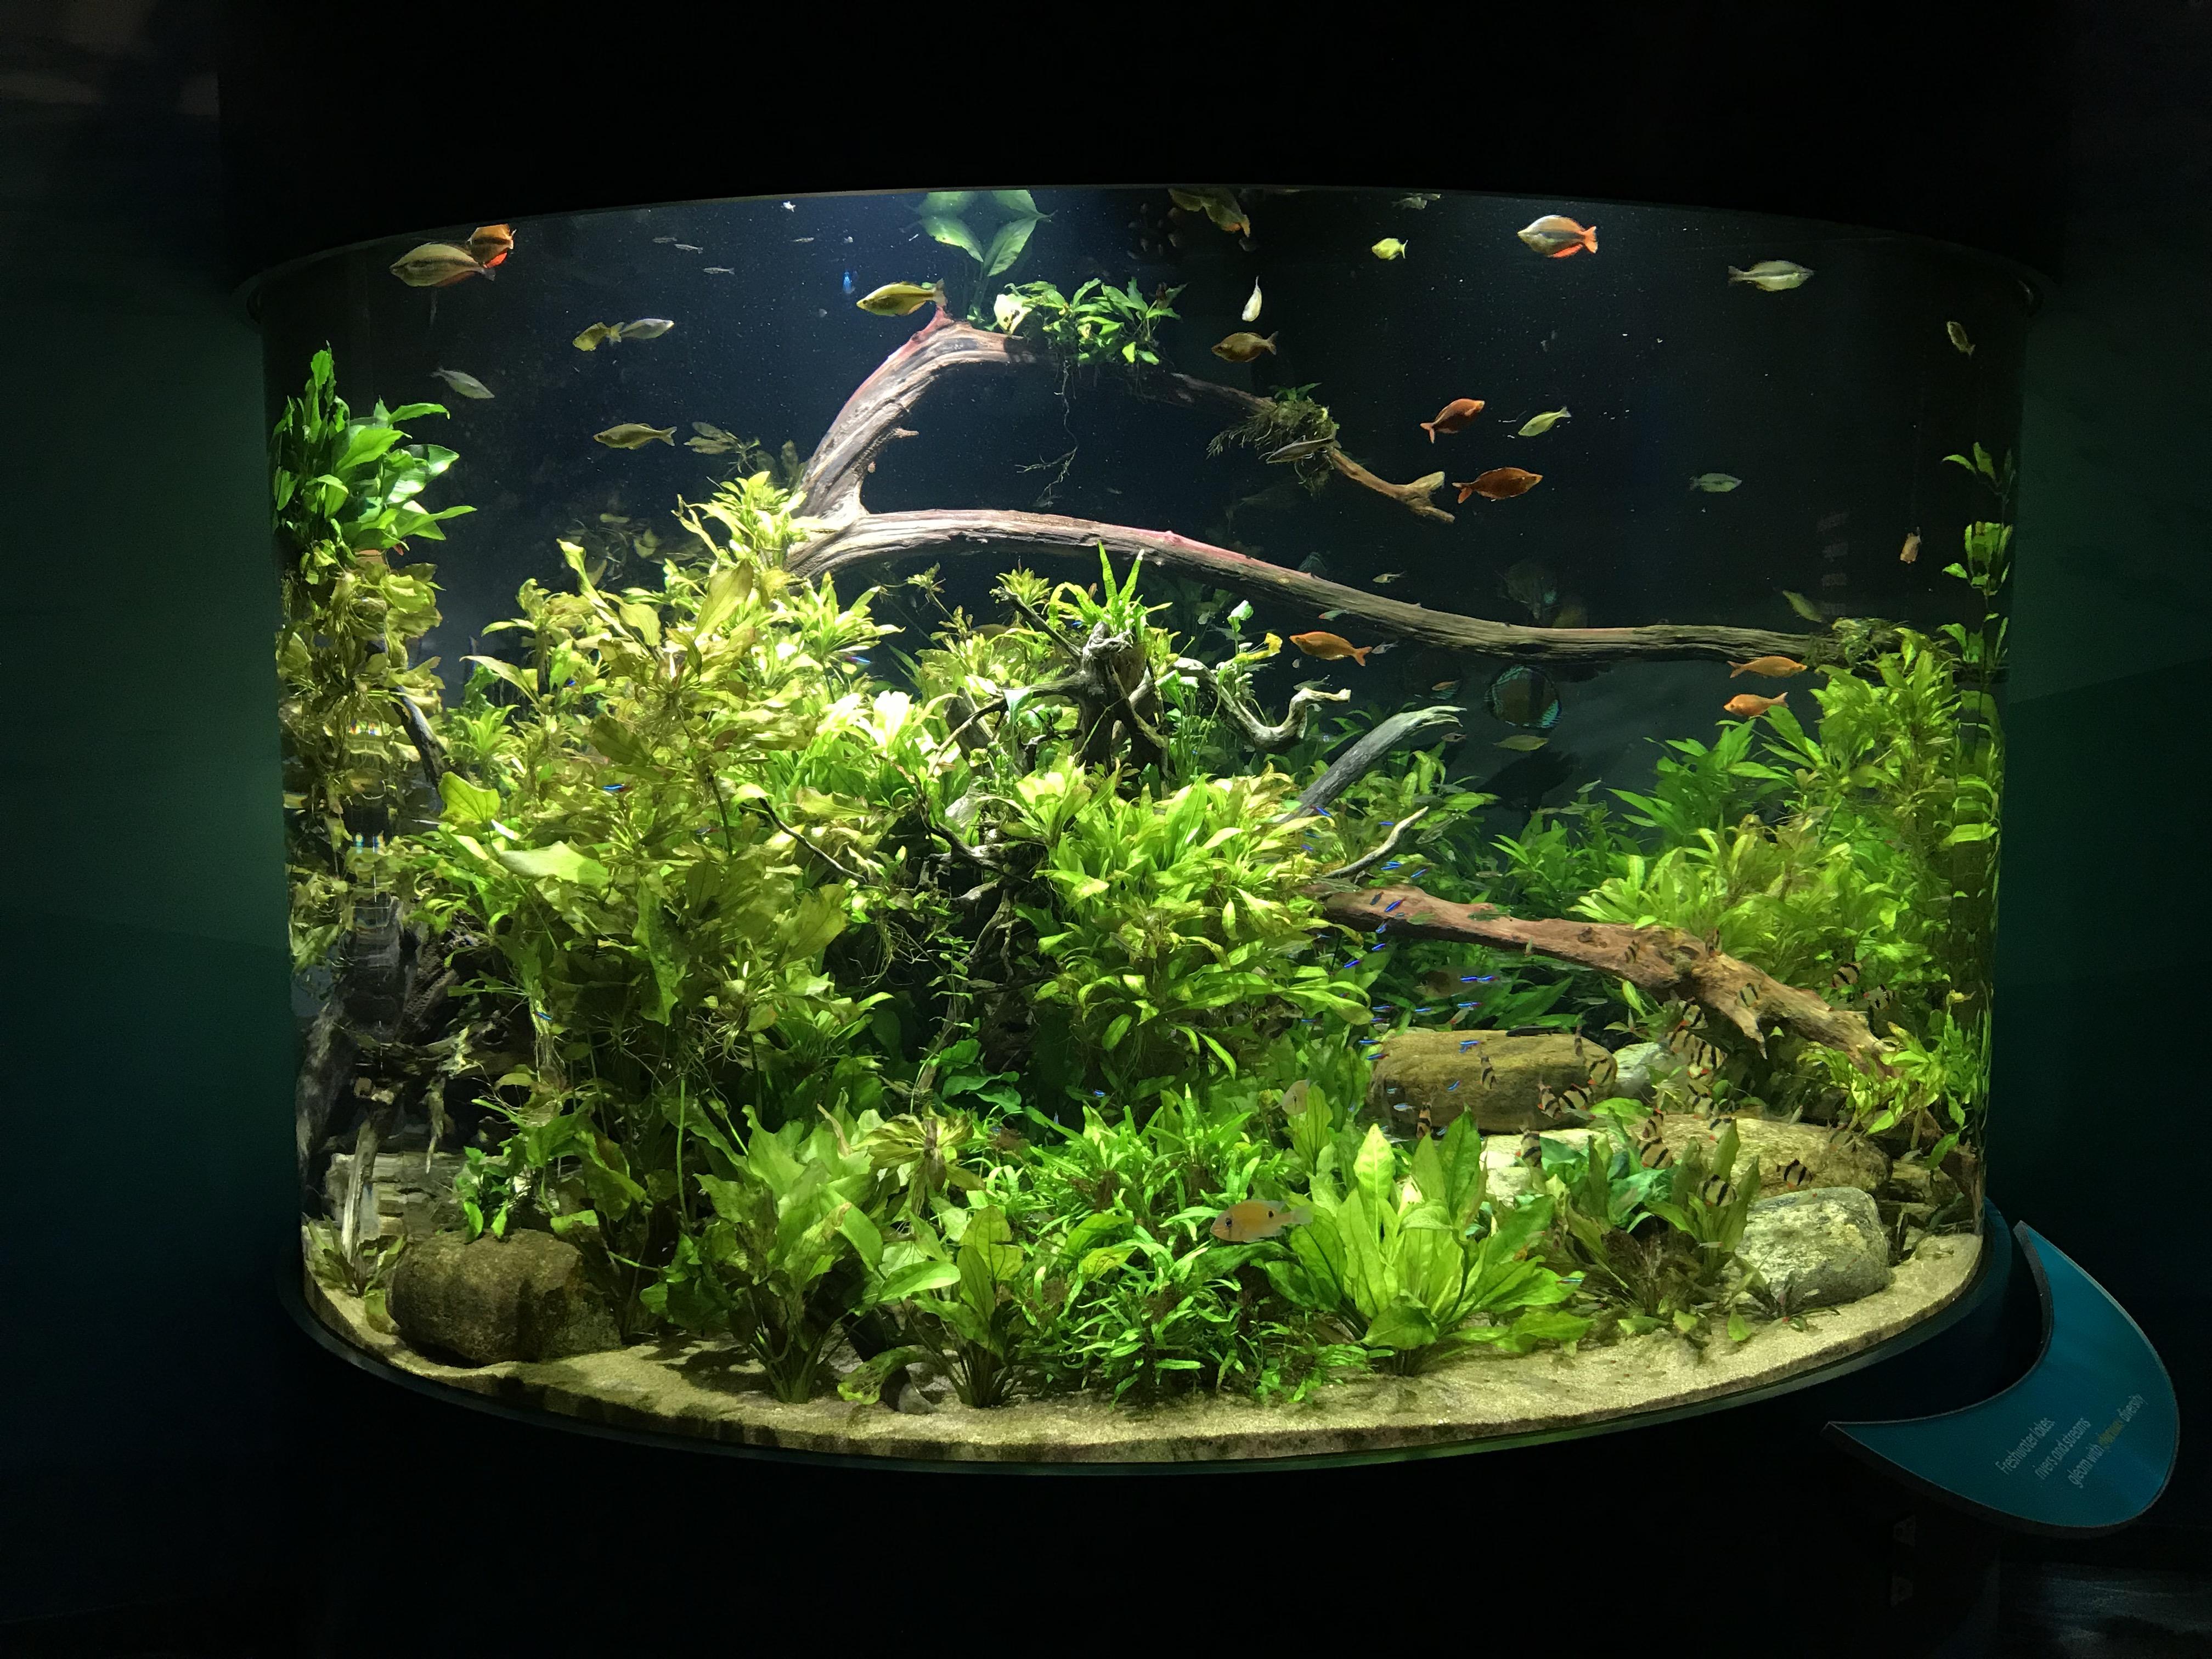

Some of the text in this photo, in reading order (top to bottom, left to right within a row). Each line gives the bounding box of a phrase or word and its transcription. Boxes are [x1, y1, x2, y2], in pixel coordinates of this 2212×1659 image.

[1995, 1432, 2039, 1475] Freshwater
[2032, 1418, 2091, 1480] rivers and streams
[2067, 1393, 2149, 1488] gleam with diversity
